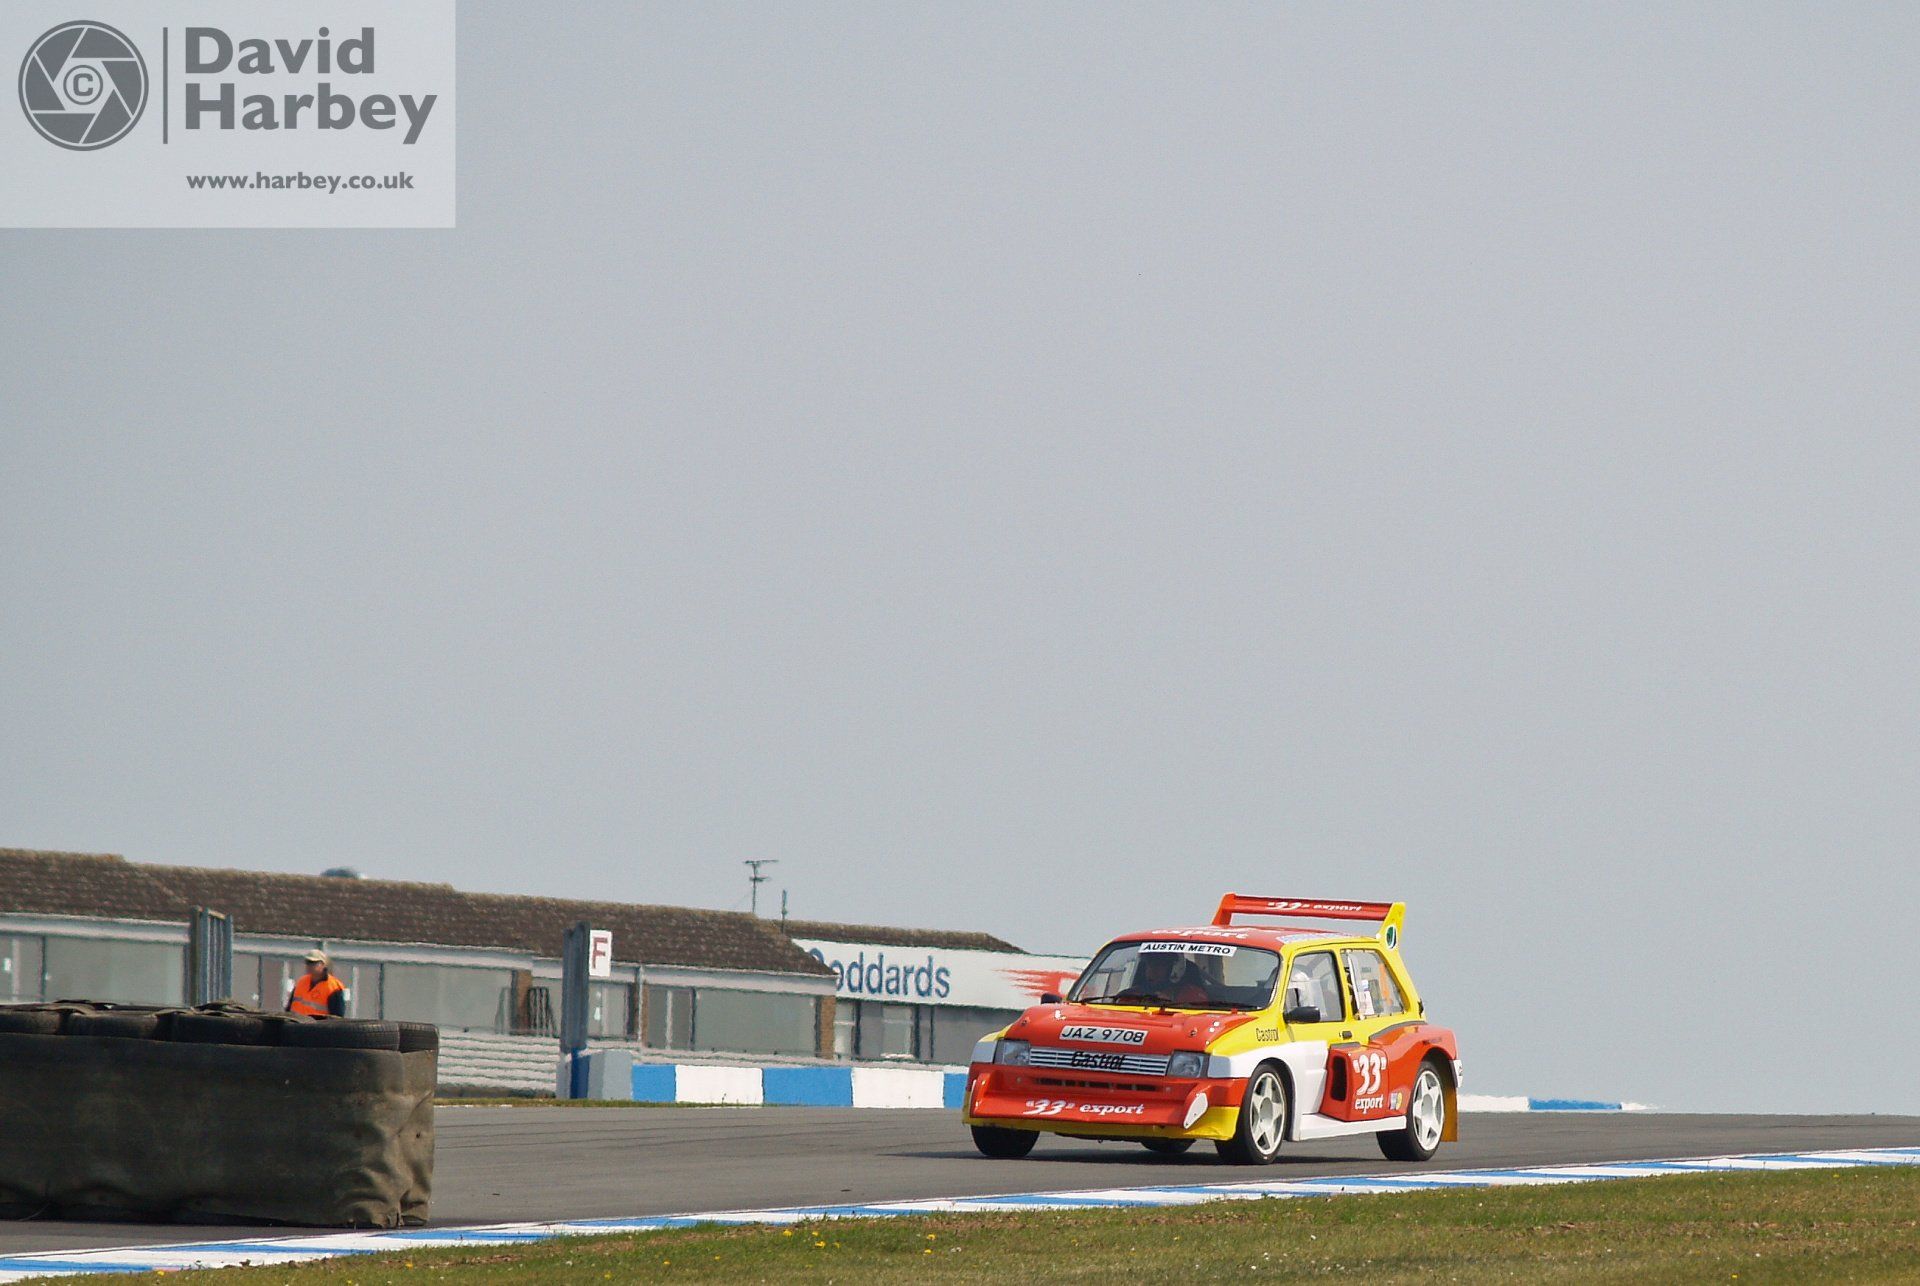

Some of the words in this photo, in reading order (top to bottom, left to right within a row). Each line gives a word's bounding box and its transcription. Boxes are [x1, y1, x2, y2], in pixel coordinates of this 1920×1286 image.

[592, 937, 608, 969] F
[1143, 943, 1185, 951] AUSTIN
[1188, 944, 1231, 955] METRO
[1062, 1027, 1097, 1039] JAZ
[1102, 1029, 1145, 1043] 9708
[1255, 1027, 1279, 1042] Castrol
[1071, 1051, 1126, 1070] Castrol
[1080, 1103, 1145, 1115] export
[1354, 1094, 1384, 1114] export
